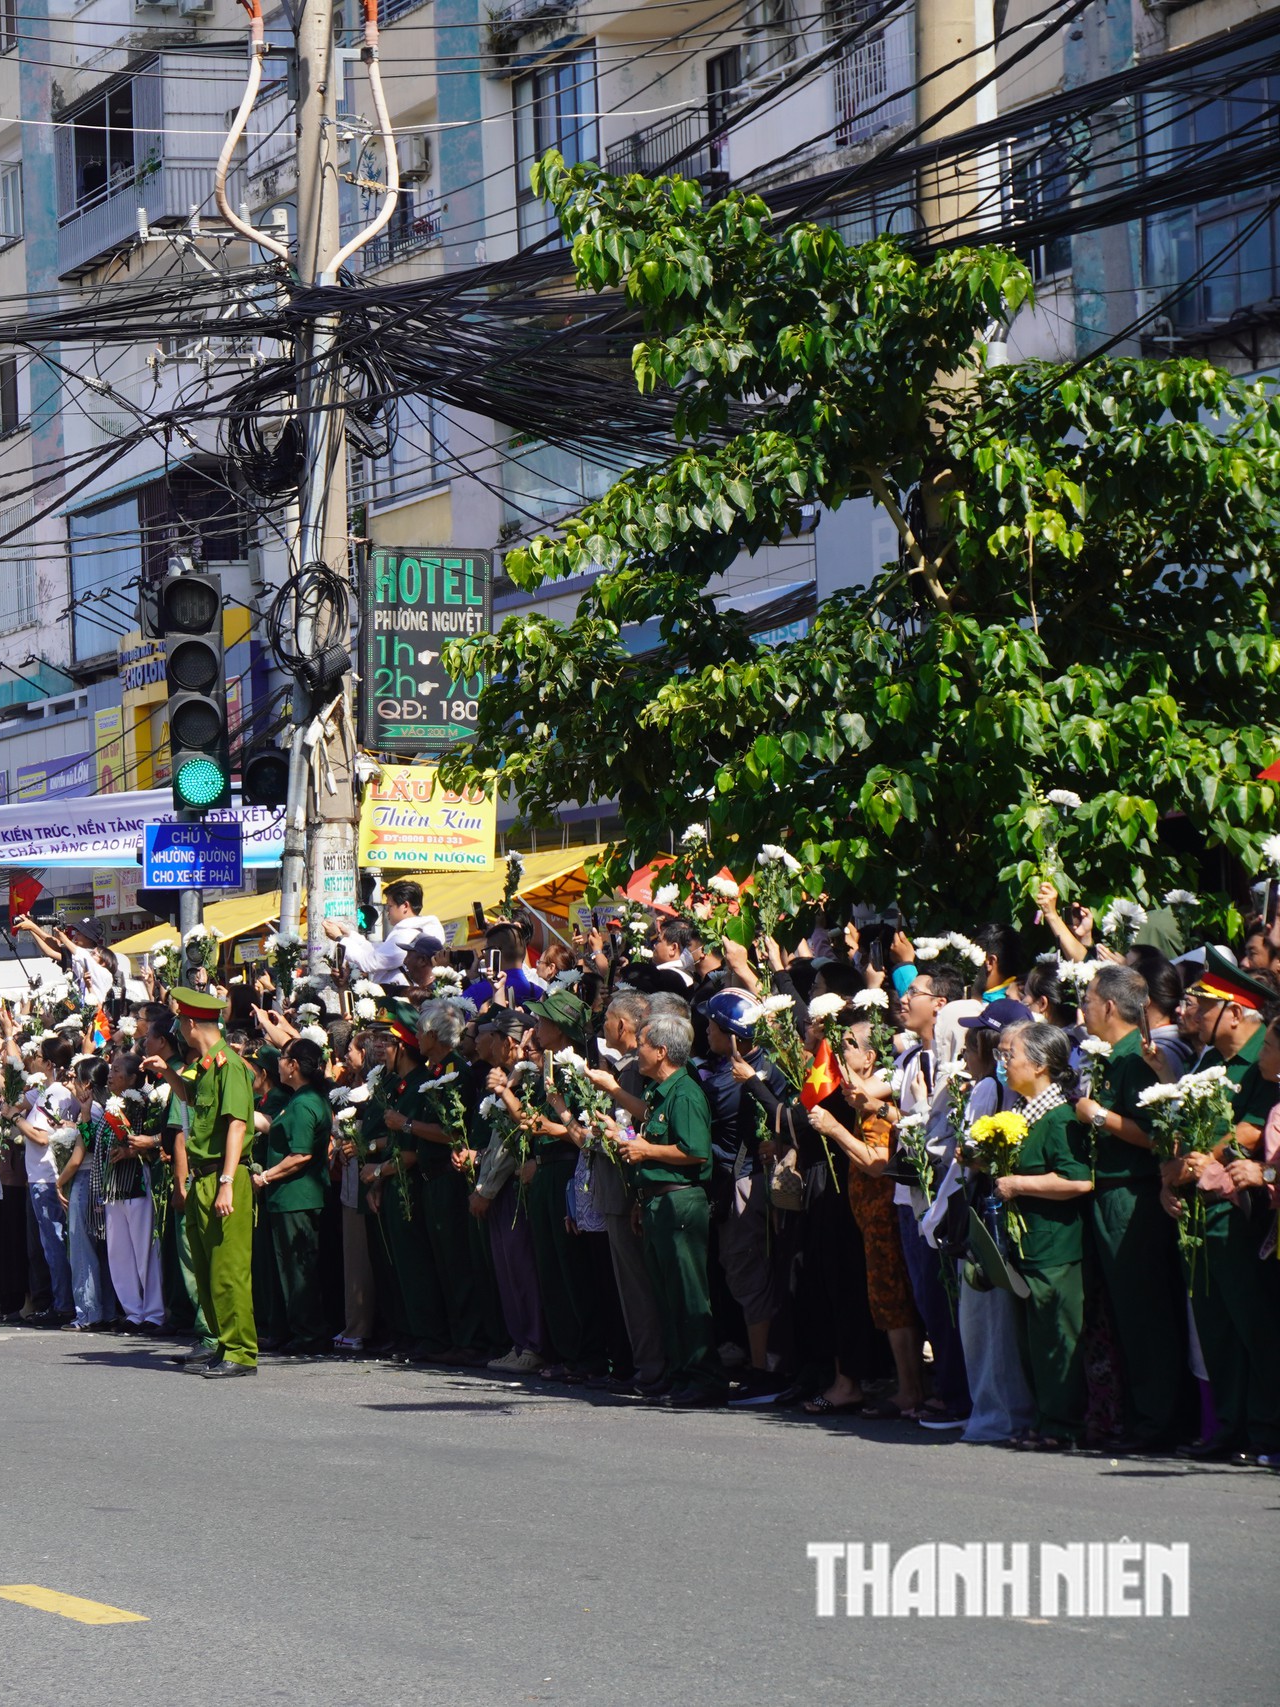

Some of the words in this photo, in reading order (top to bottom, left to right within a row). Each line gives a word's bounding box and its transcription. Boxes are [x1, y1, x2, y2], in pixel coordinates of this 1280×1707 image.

[376, 557, 483, 605] HOTEL
[375, 607, 428, 632] PHƯƠNG
[432, 607, 483, 636] NGUYỆT
[376, 636, 414, 665] 1h
[374, 668, 416, 698] 2h
[378, 700, 426, 719] QĐ:
[74, 763, 88, 782] LỚN
[370, 770, 433, 802] LẨU
[436, 808, 482, 830] Kim
[2, 825, 32, 842] KIẾN
[34, 824, 76, 839] TRÚC,
[77, 819, 106, 836] NỀN
[172, 827, 200, 844] CHÚ
[204, 826, 212, 844] Ý
[50, 840, 88, 854] NÂNG
[92, 839, 119, 852] CAO
[150, 847, 194, 863] NHƯỜNG
[200, 846, 236, 862] ĐƯỜNG
[368, 849, 388, 860] CÓ
[434, 850, 486, 864] NƯỚNG
[152, 870, 174, 882] CHO
[176, 870, 190, 882] XE
[210, 865, 234, 882] PHẢI
